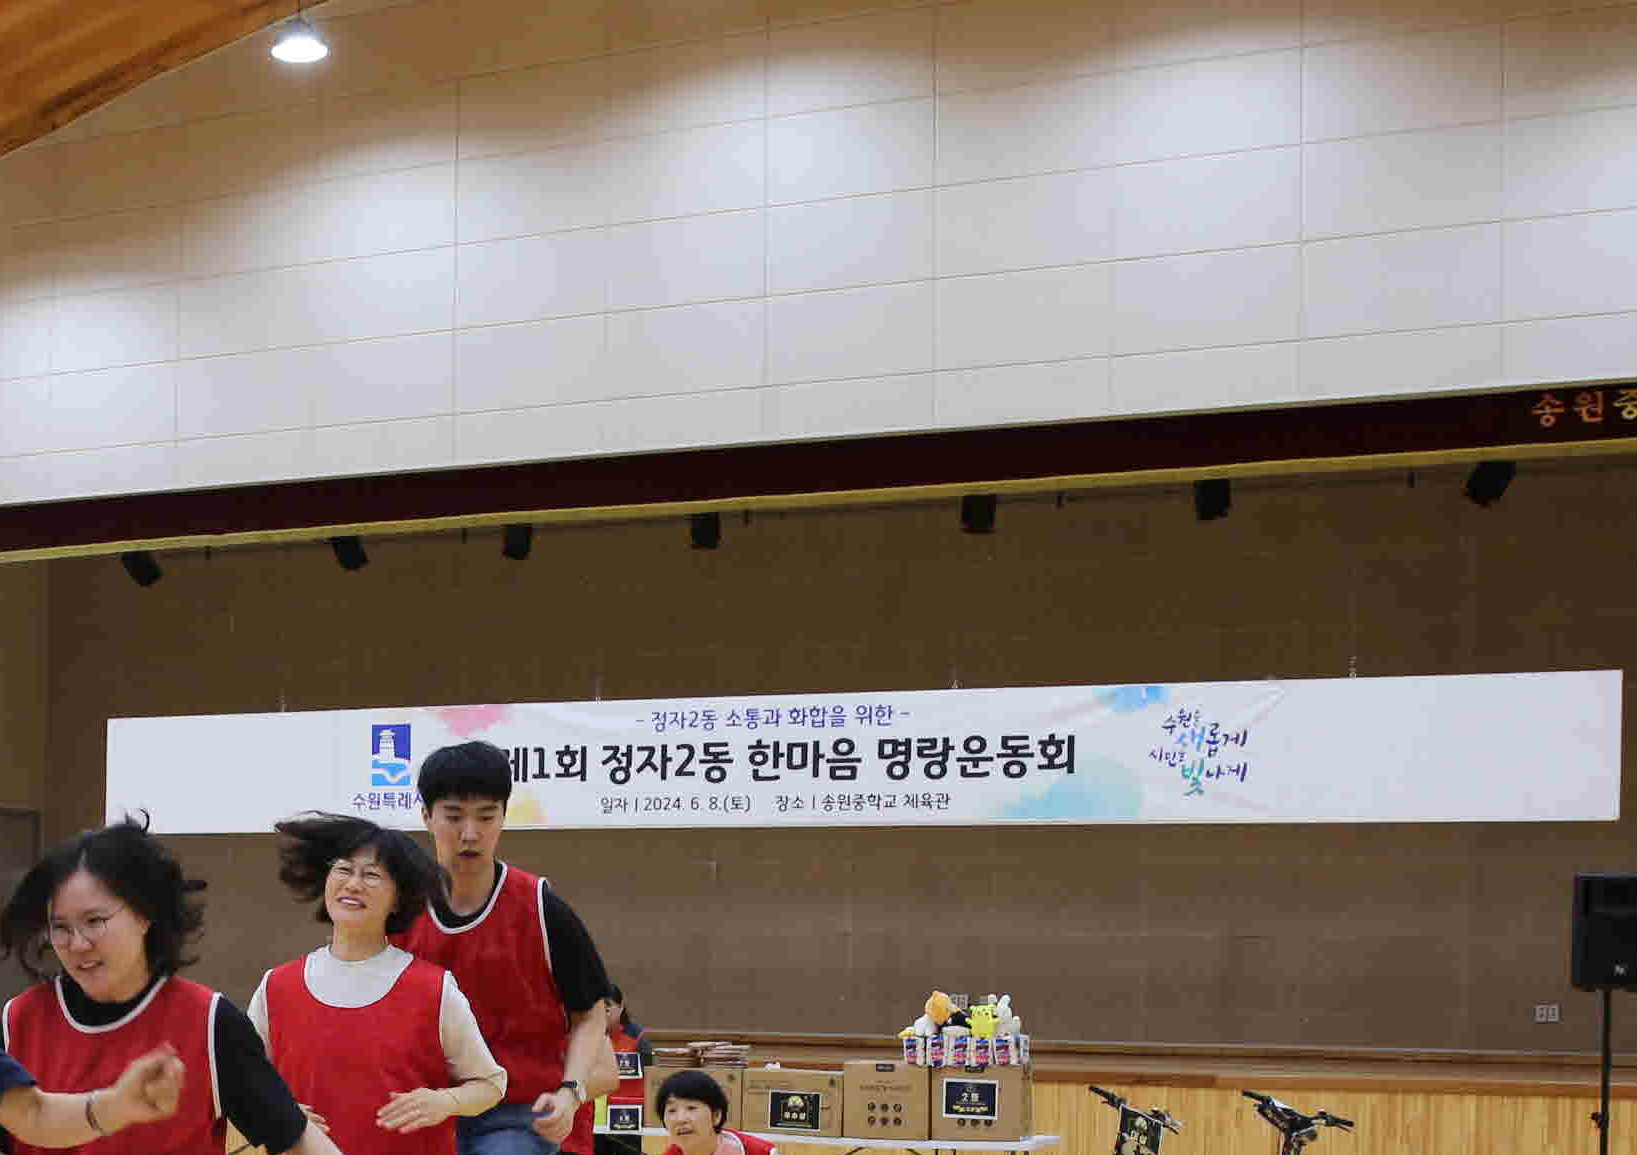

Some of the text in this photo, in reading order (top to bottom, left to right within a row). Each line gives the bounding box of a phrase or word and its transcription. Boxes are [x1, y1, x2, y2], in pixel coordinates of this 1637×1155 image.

[651, 709, 717, 733] 정자2동
[725, 707, 782, 730] 소통과
[787, 704, 847, 729] 화합을
[854, 703, 893, 727] 위한
[600, 743, 734, 785] 정자2동
[748, 737, 862, 782] 한마음
[877, 734, 1075, 781] 명랑운동회
[600, 796, 629, 814] 일자
[774, 794, 805, 812] 장소
[821, 792, 897, 812] 송원중학교
[902, 792, 952, 811] 체육관
